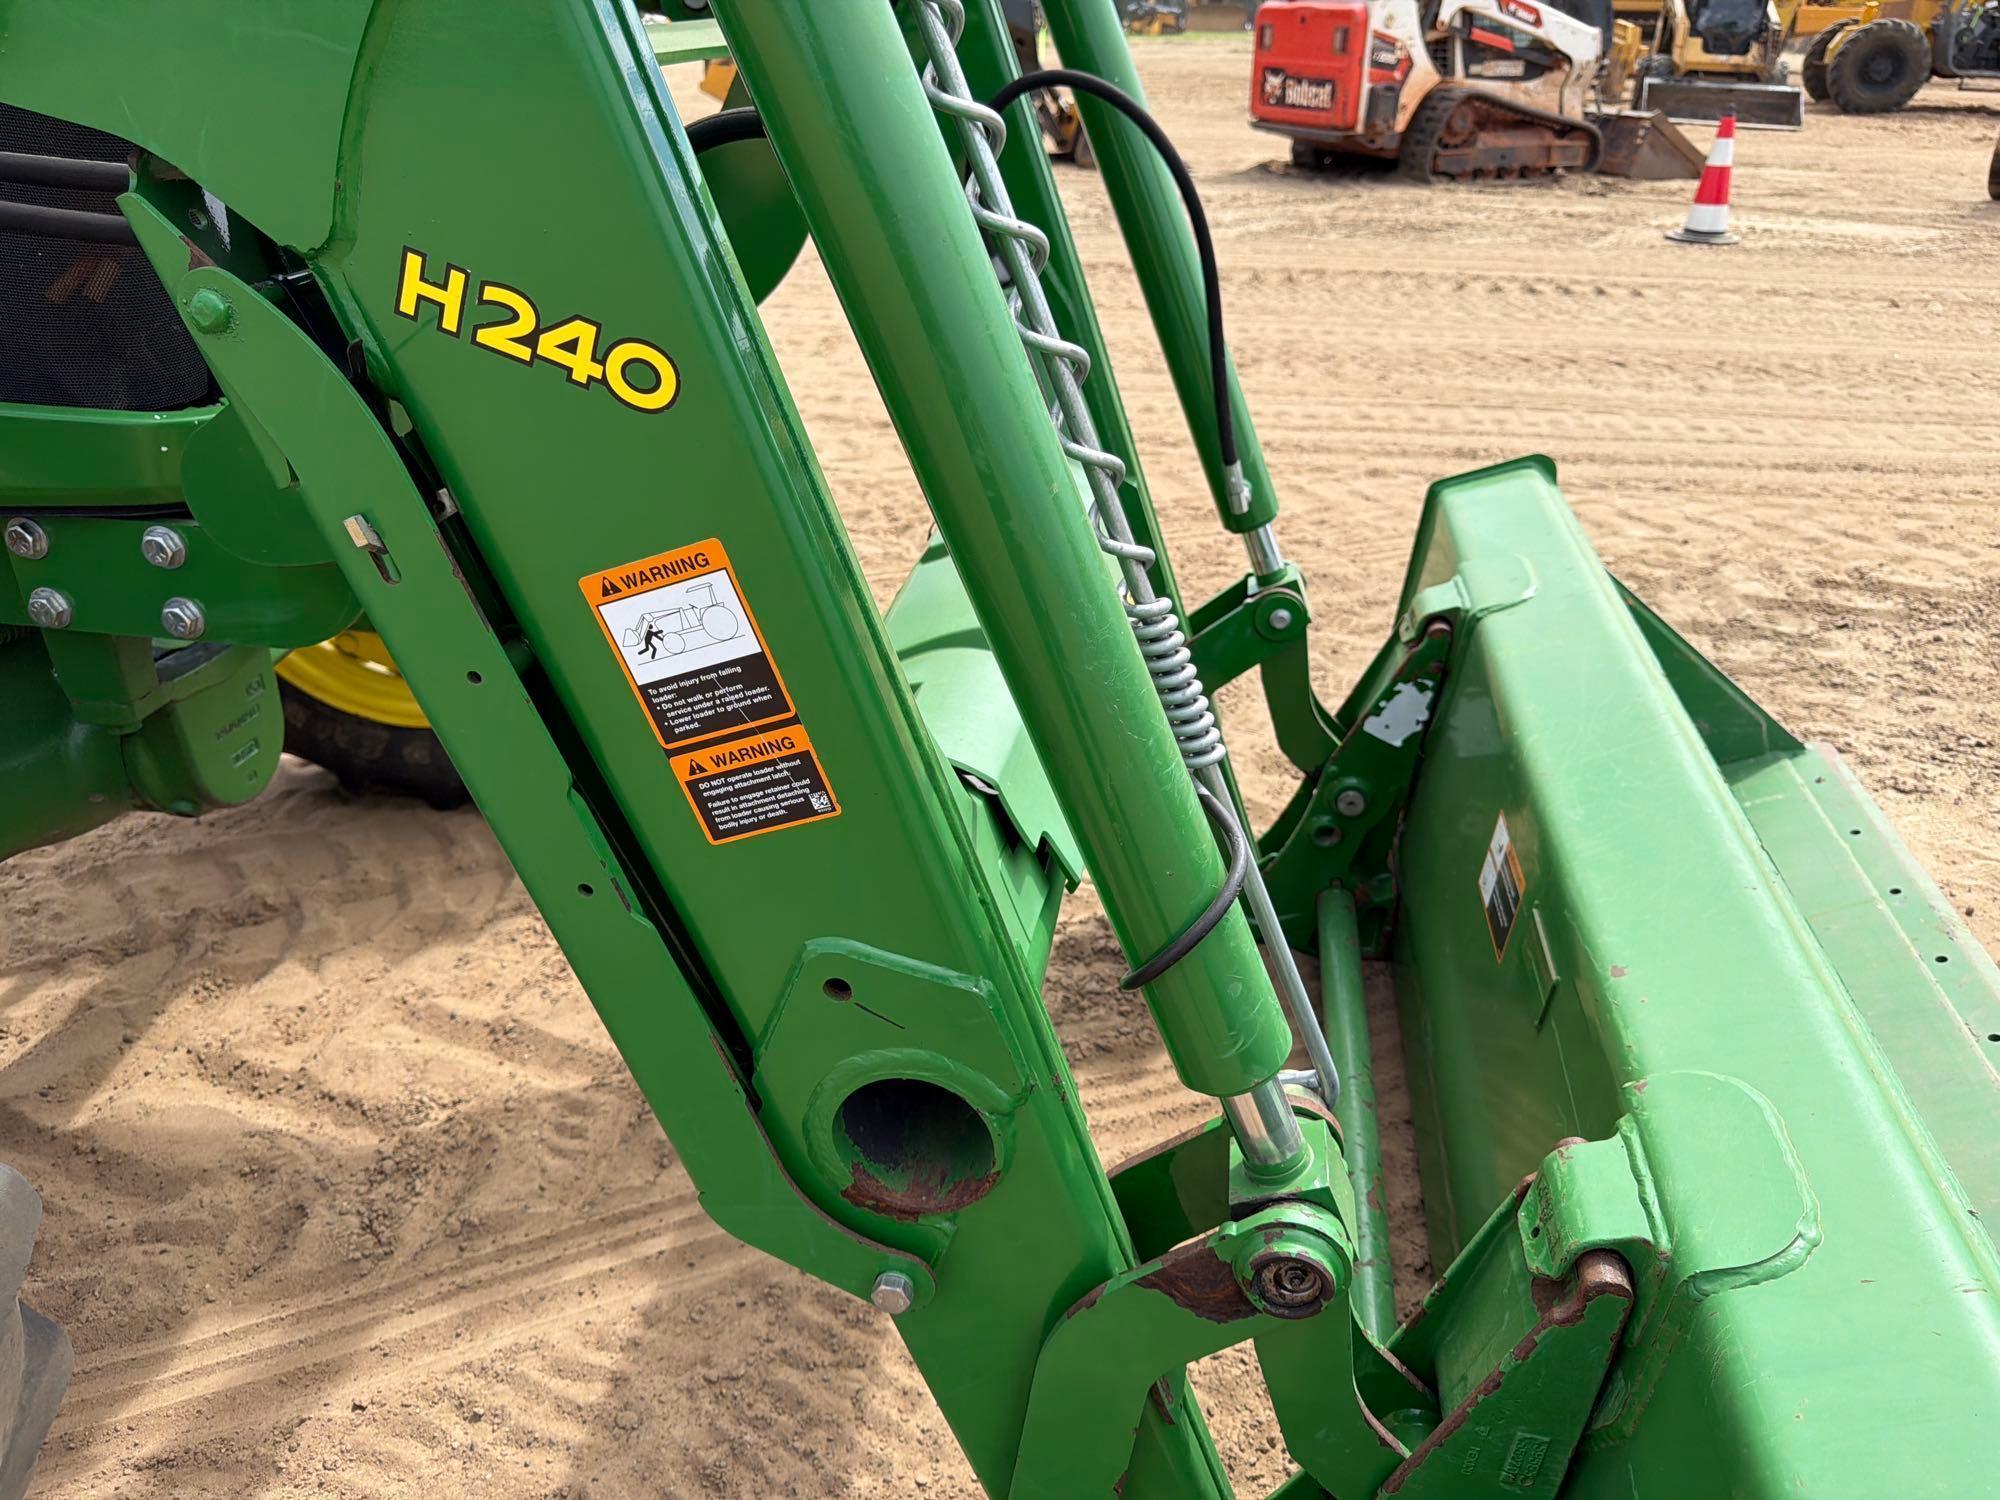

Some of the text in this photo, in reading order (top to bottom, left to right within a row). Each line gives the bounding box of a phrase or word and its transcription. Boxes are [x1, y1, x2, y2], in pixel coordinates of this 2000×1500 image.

[394, 245, 680, 414] H240
[619, 552, 711, 590] WARNING
[659, 683, 678, 693] avoid
[679, 677, 699, 688] injury
[700, 672, 717, 682] from
[718, 666, 742, 676] falling
[651, 693, 678, 704] loader:
[666, 707, 693, 718] service
[693, 700, 714, 711] under
[721, 692, 744, 702] raised
[744, 686, 770, 696] loader.
[669, 715, 692, 726] Lower
[692, 708, 716, 719] loader
[726, 699, 752, 711] ground
[752, 694, 773, 703] when
[673, 699, 686, 707] not
[687, 694, 704, 704] walk
[714, 684, 743, 697] perform
[674, 721, 701, 735] parked.
[709, 736, 796, 768] WARNING
[699, 759, 801, 790] DO NOT operate loader without
[703, 785, 734, 797] engaging
[734, 775, 772, 789] attachment
[707, 798, 731, 809] Failure
[739, 790, 764, 800] engage
[765, 783, 791, 794] retainer
[791, 778, 811, 788] could
[711, 806, 731, 816] result
[738, 795, 776, 809] attachment
[777, 787, 810, 800] detaching
[715, 797, 805, 824] from loader causing serious
[718, 821, 739, 830] bodily
[739, 816, 758, 825] injury
[767, 809, 788, 818] death.
